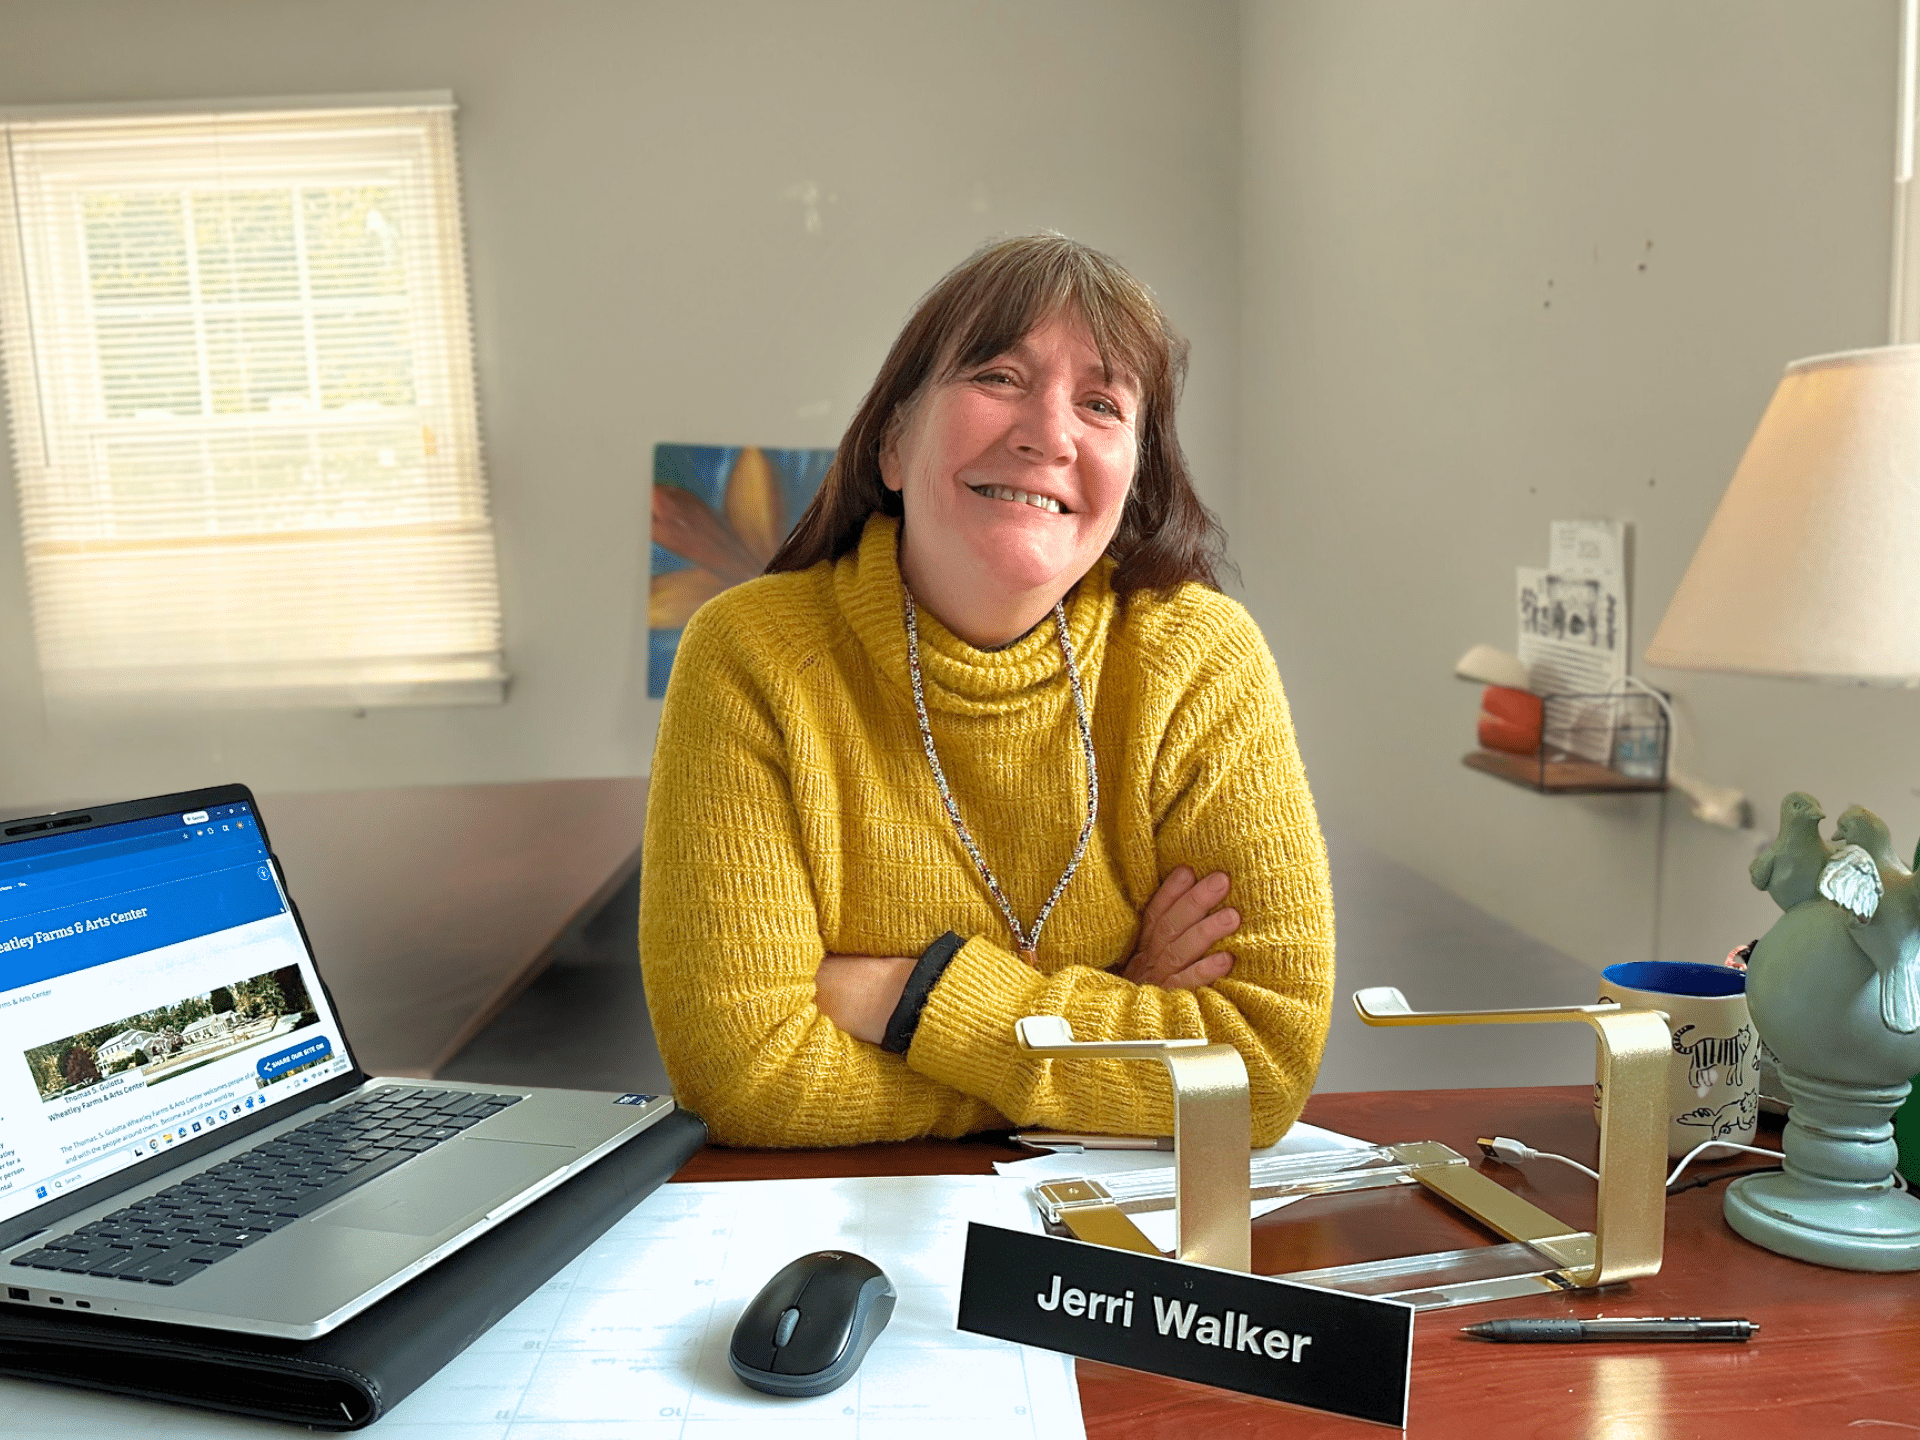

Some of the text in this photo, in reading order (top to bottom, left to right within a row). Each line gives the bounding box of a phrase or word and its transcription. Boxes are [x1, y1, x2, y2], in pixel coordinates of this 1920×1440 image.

[34, 925, 75, 943] Farms
[73, 921, 84, 933] &
[85, 917, 111, 931] Arts
[110, 907, 148, 924] Center
[19, 995, 32, 1003] Arts
[31, 989, 52, 999] Center
[271, 1056, 291, 1068] SHARE
[291, 1051, 304, 1060] OUR
[47, 1105, 81, 1122] Wheatley
[81, 1097, 103, 1109] Farms
[109, 1090, 123, 1099] Arts
[123, 1081, 145, 1094] Center
[64, 1089, 91, 1103] Thomas
[99, 1078, 124, 1092] Gulotta
[60, 1145, 72, 1154] The
[126, 1113, 152, 1128] Wheatley
[152, 1105, 170, 1117] Farms
[174, 1099, 185, 1108] Arts
[185, 1093, 202, 1104] Center
[202, 1083, 228, 1096] welcomes
[65, 1155, 78, 1165] and
[77, 1149, 92, 1161] with
[91, 1145, 102, 1155] the
[102, 1137, 122, 1150] people
[122, 1127, 143, 1141] around
[160, 1112, 182, 1126] Become
[186, 1105, 197, 1116] part
[203, 1100, 213, 1108] our
[4, 1167, 25, 1180] person
[1037, 1275, 1312, 1363] Jerri Walker
[659, 1406, 682, 1418] 10
